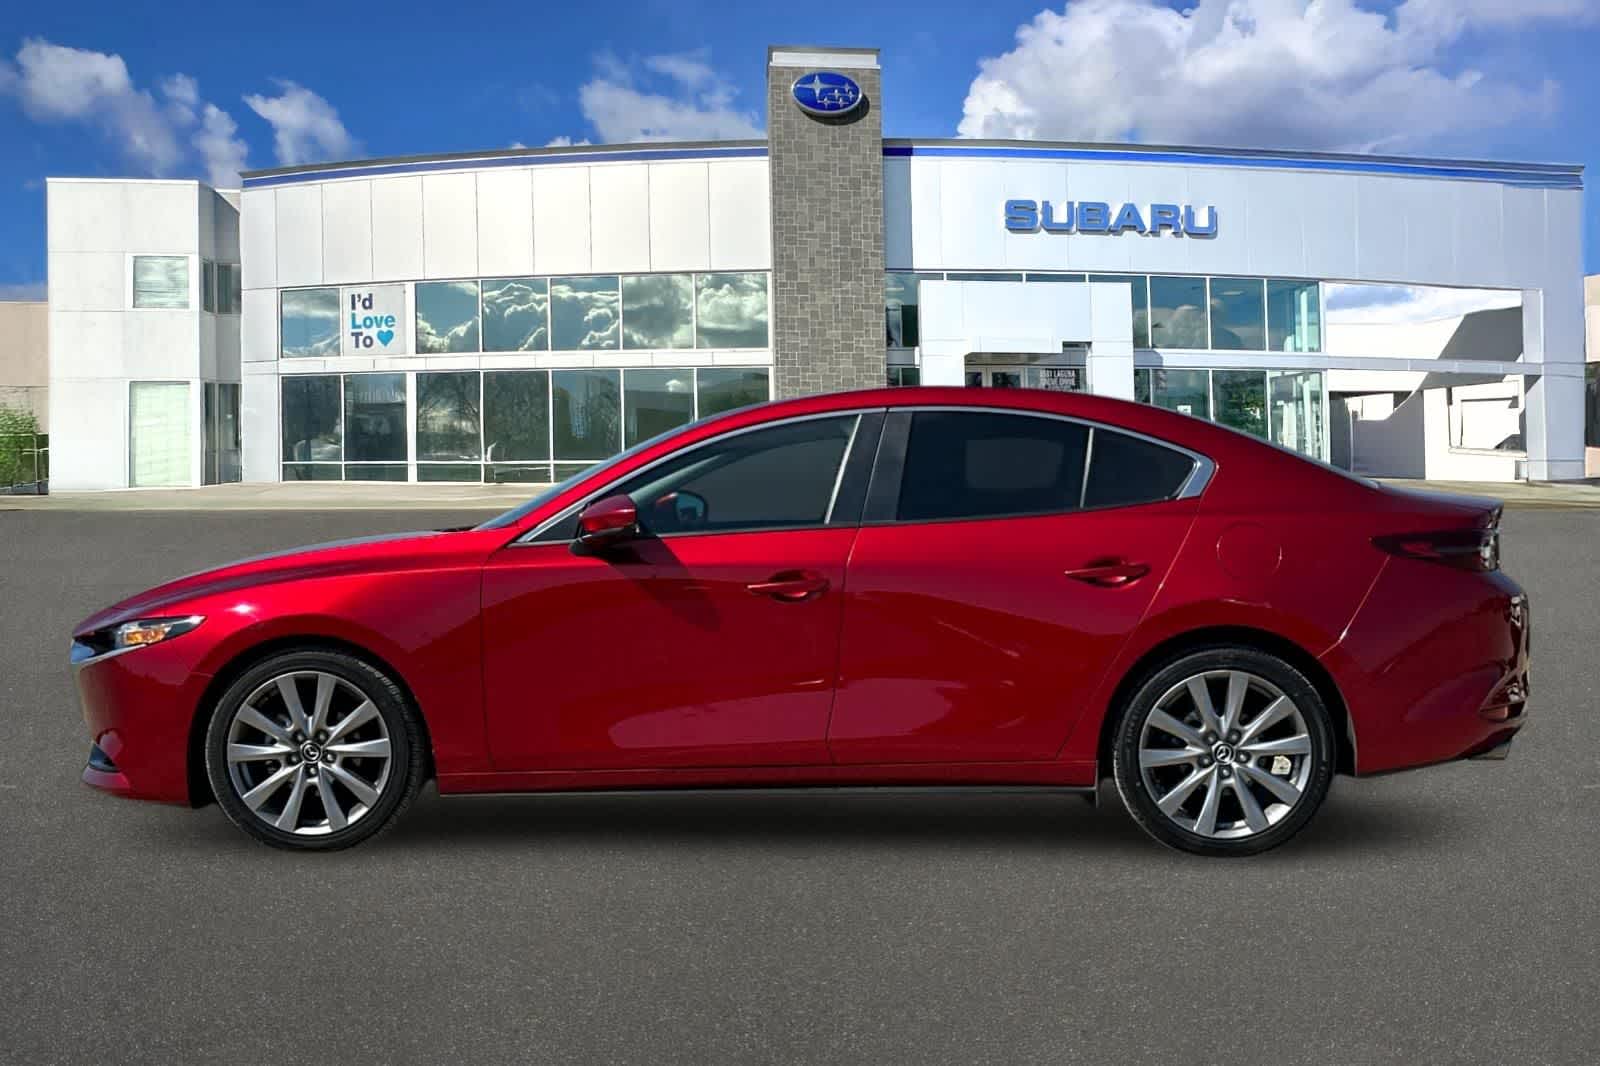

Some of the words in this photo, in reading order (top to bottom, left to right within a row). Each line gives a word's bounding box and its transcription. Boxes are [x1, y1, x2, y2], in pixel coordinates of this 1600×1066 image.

[1005, 199, 1217, 238] SUBARU
[351, 293, 373, 310] I'd
[351, 313, 396, 329] Love
[351, 332, 374, 348] To
